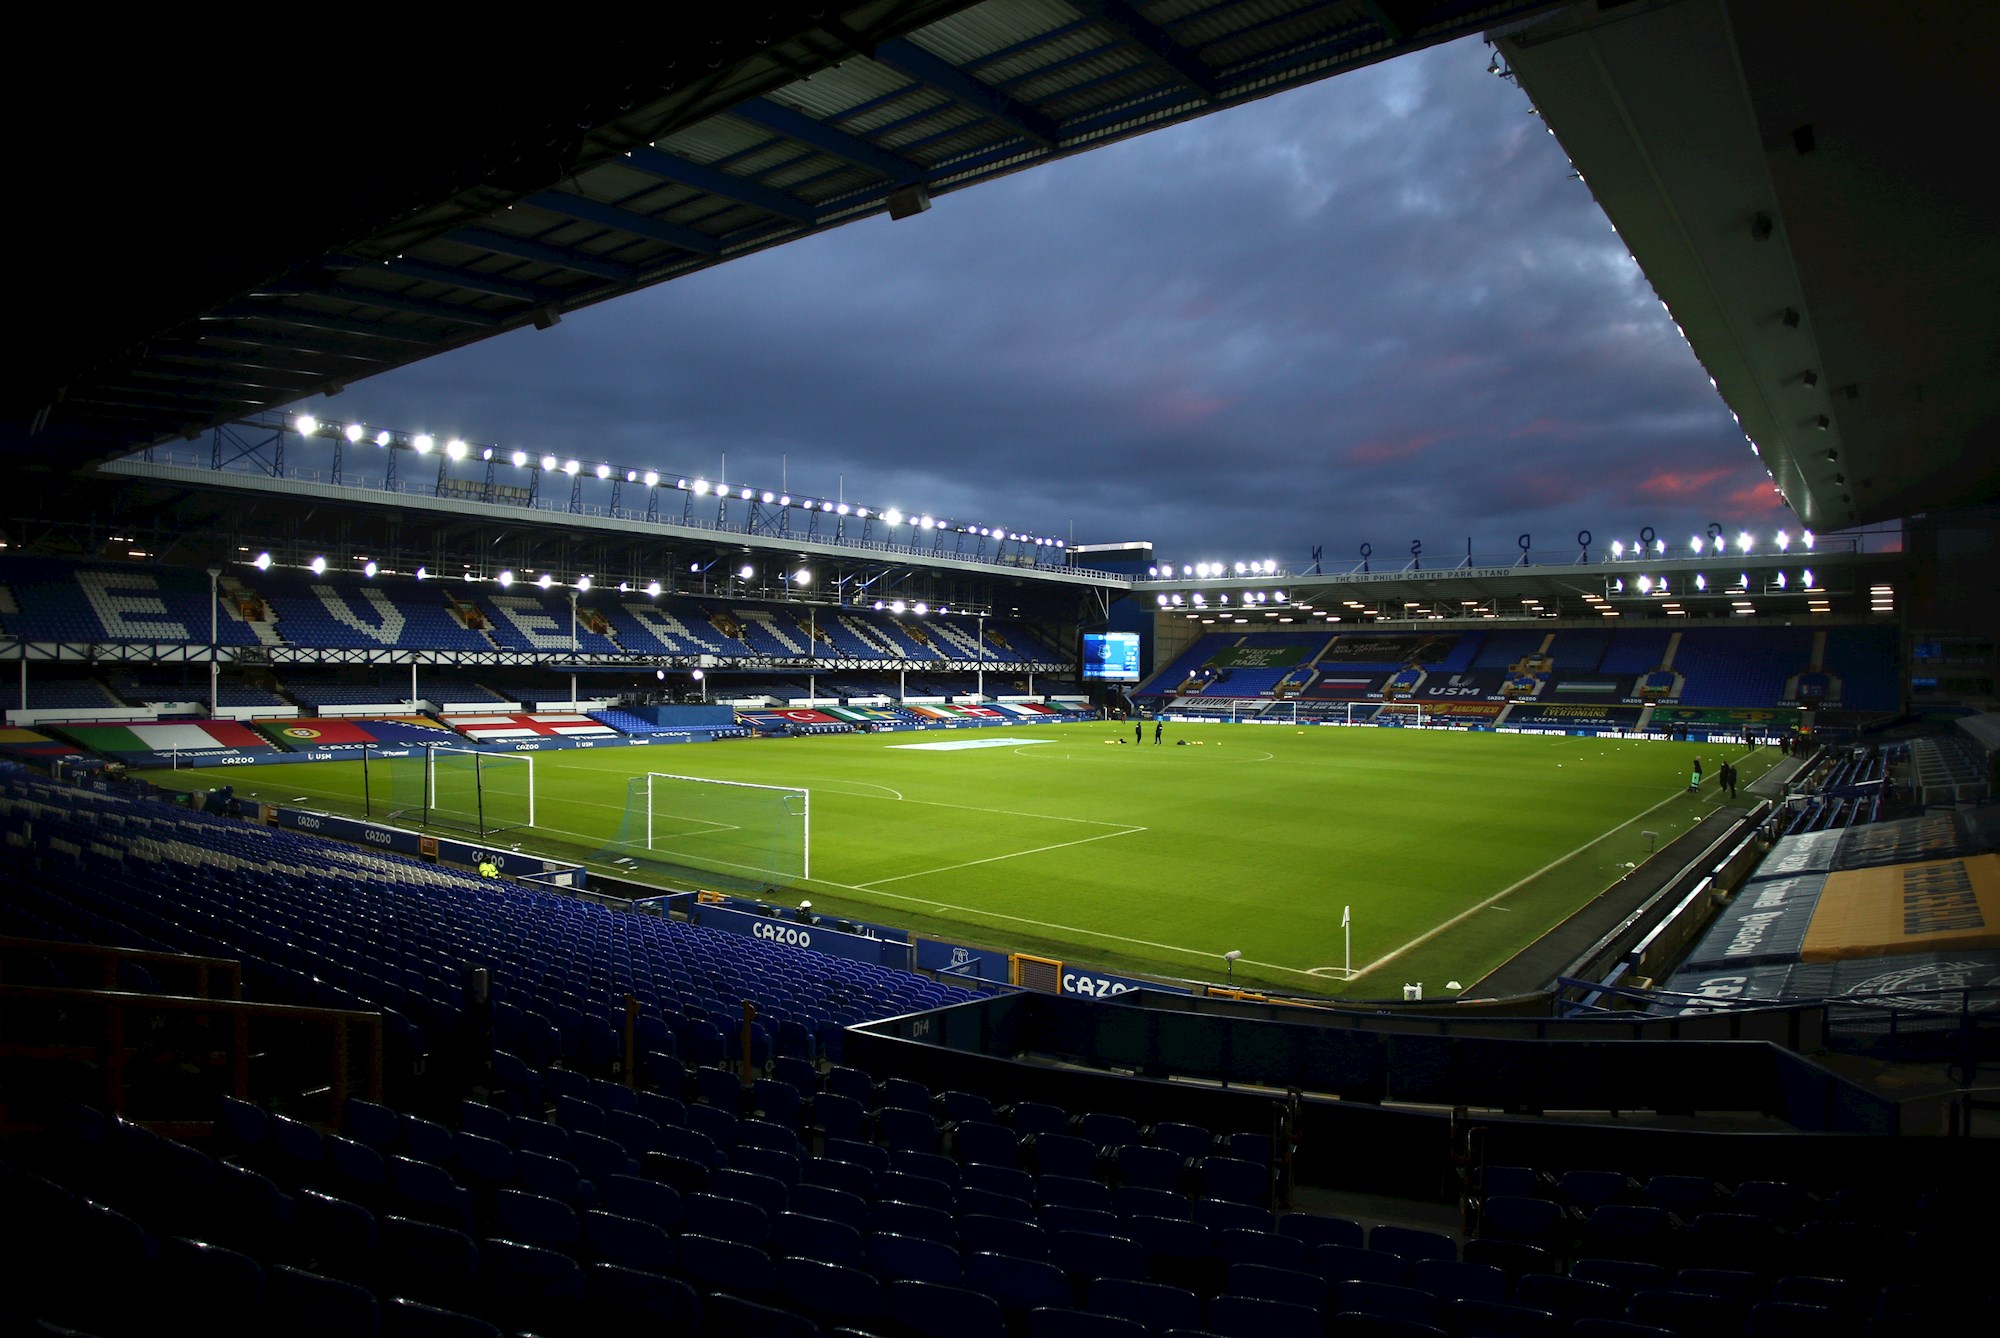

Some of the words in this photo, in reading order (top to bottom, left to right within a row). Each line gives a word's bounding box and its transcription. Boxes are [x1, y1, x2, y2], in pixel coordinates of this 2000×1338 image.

[1407, 572, 1443, 580] CARTER
[1448, 570, 1473, 578] PARK
[1478, 569, 1510, 577] STAND
[1429, 687, 1481, 696] USM
[1543, 709, 1607, 717] EVERTONIANS
[1708, 735, 1736, 743] EVERTON
[176, 749, 240, 757] hummel
[297, 815, 320, 829] CAZOO
[365, 829, 391, 845] CAZOO
[472, 851, 504, 868] CAOO
[753, 922, 810, 948] CAZOO
[1063, 974, 1139, 998] CAZO
